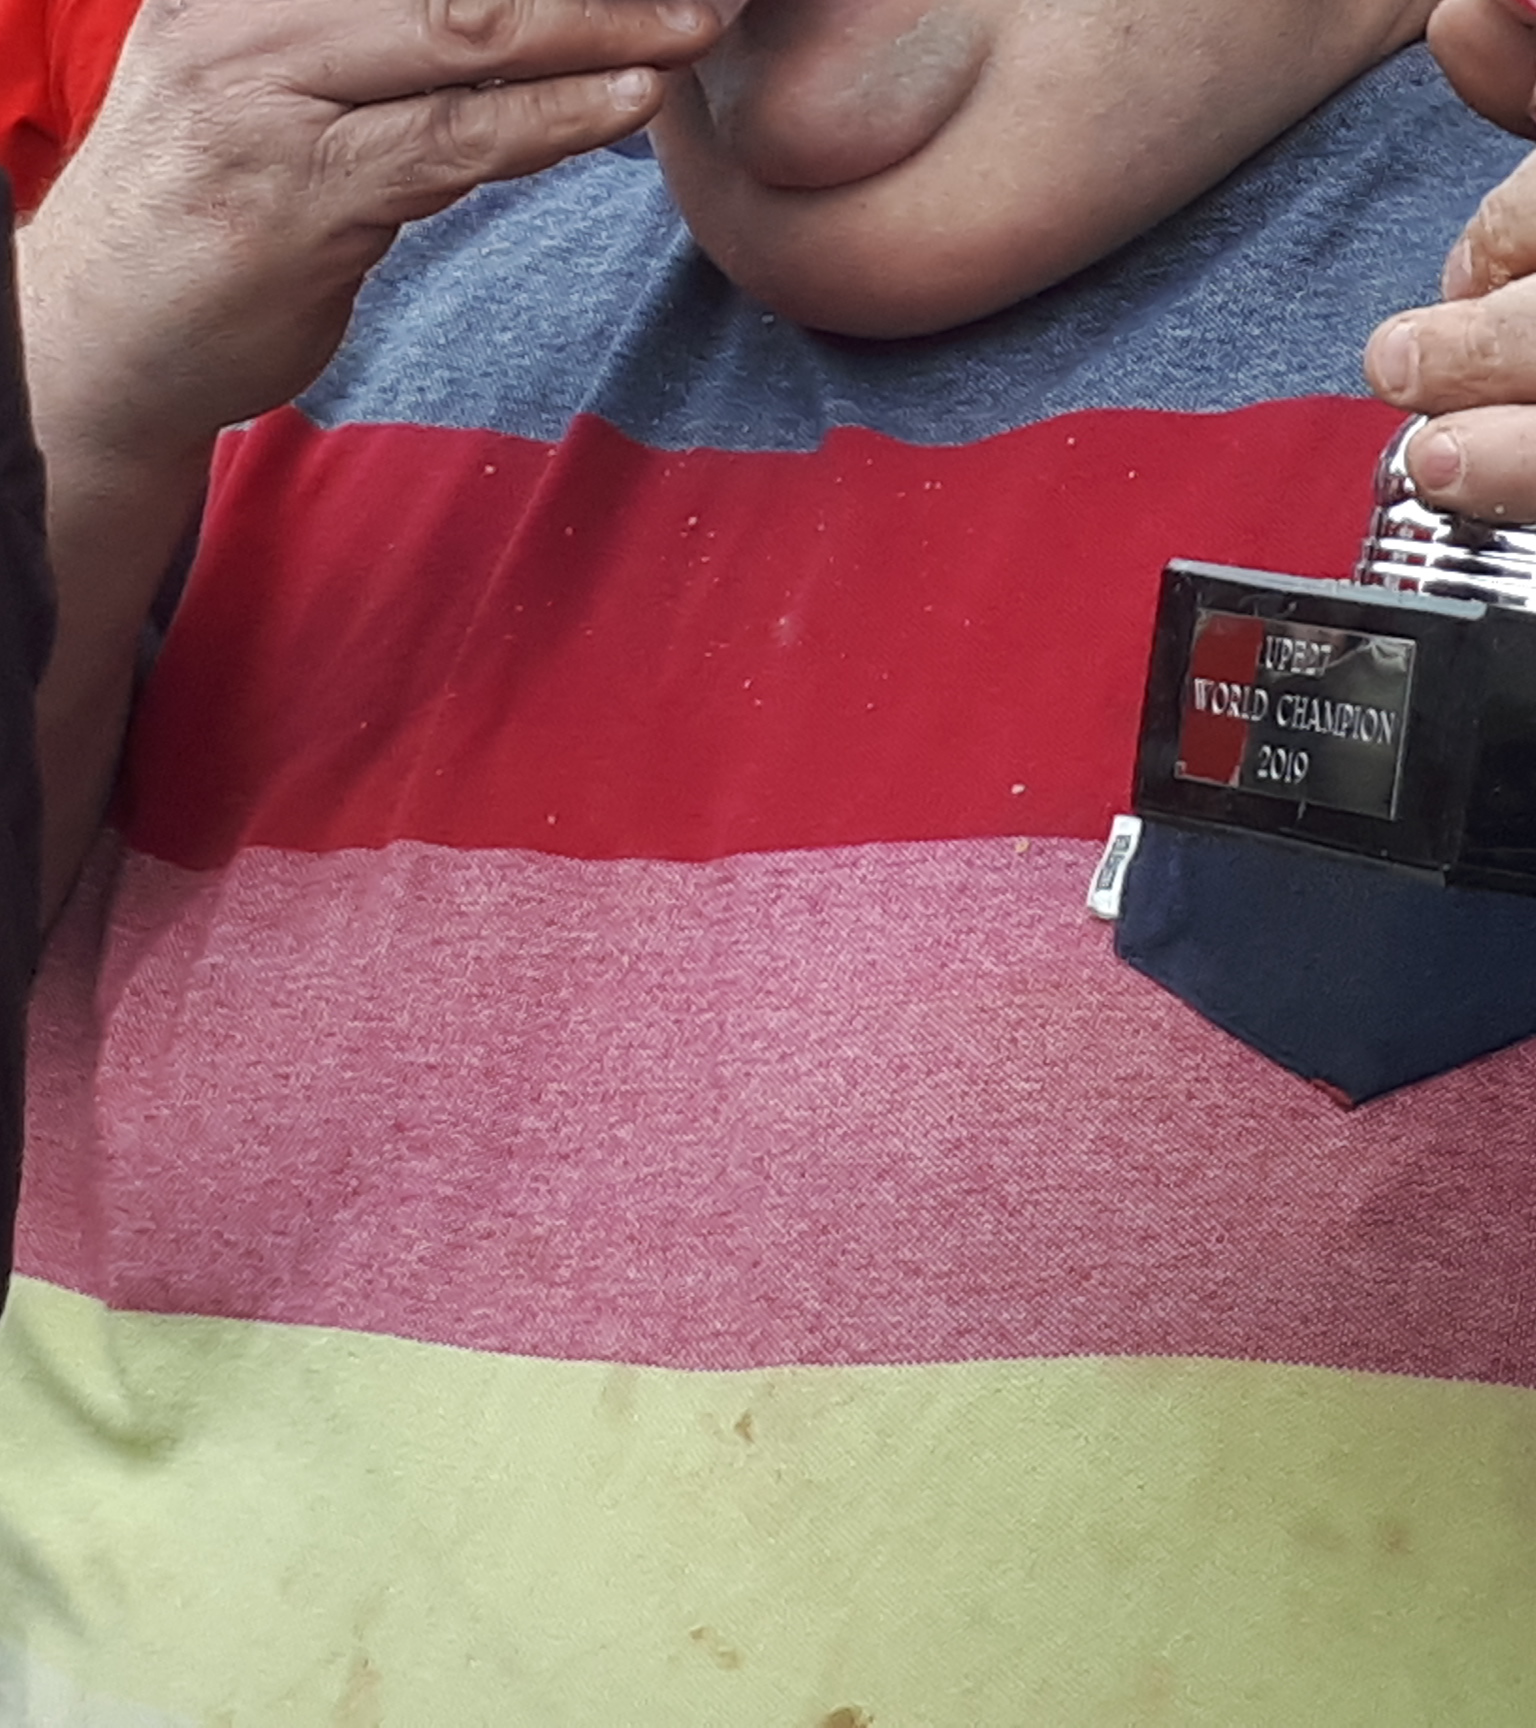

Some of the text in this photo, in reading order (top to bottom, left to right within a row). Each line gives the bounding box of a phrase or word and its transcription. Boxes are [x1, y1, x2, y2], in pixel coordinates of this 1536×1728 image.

[1194, 677, 1396, 745] WORLD CHAMPION
[1256, 744, 1310, 784] 2019
